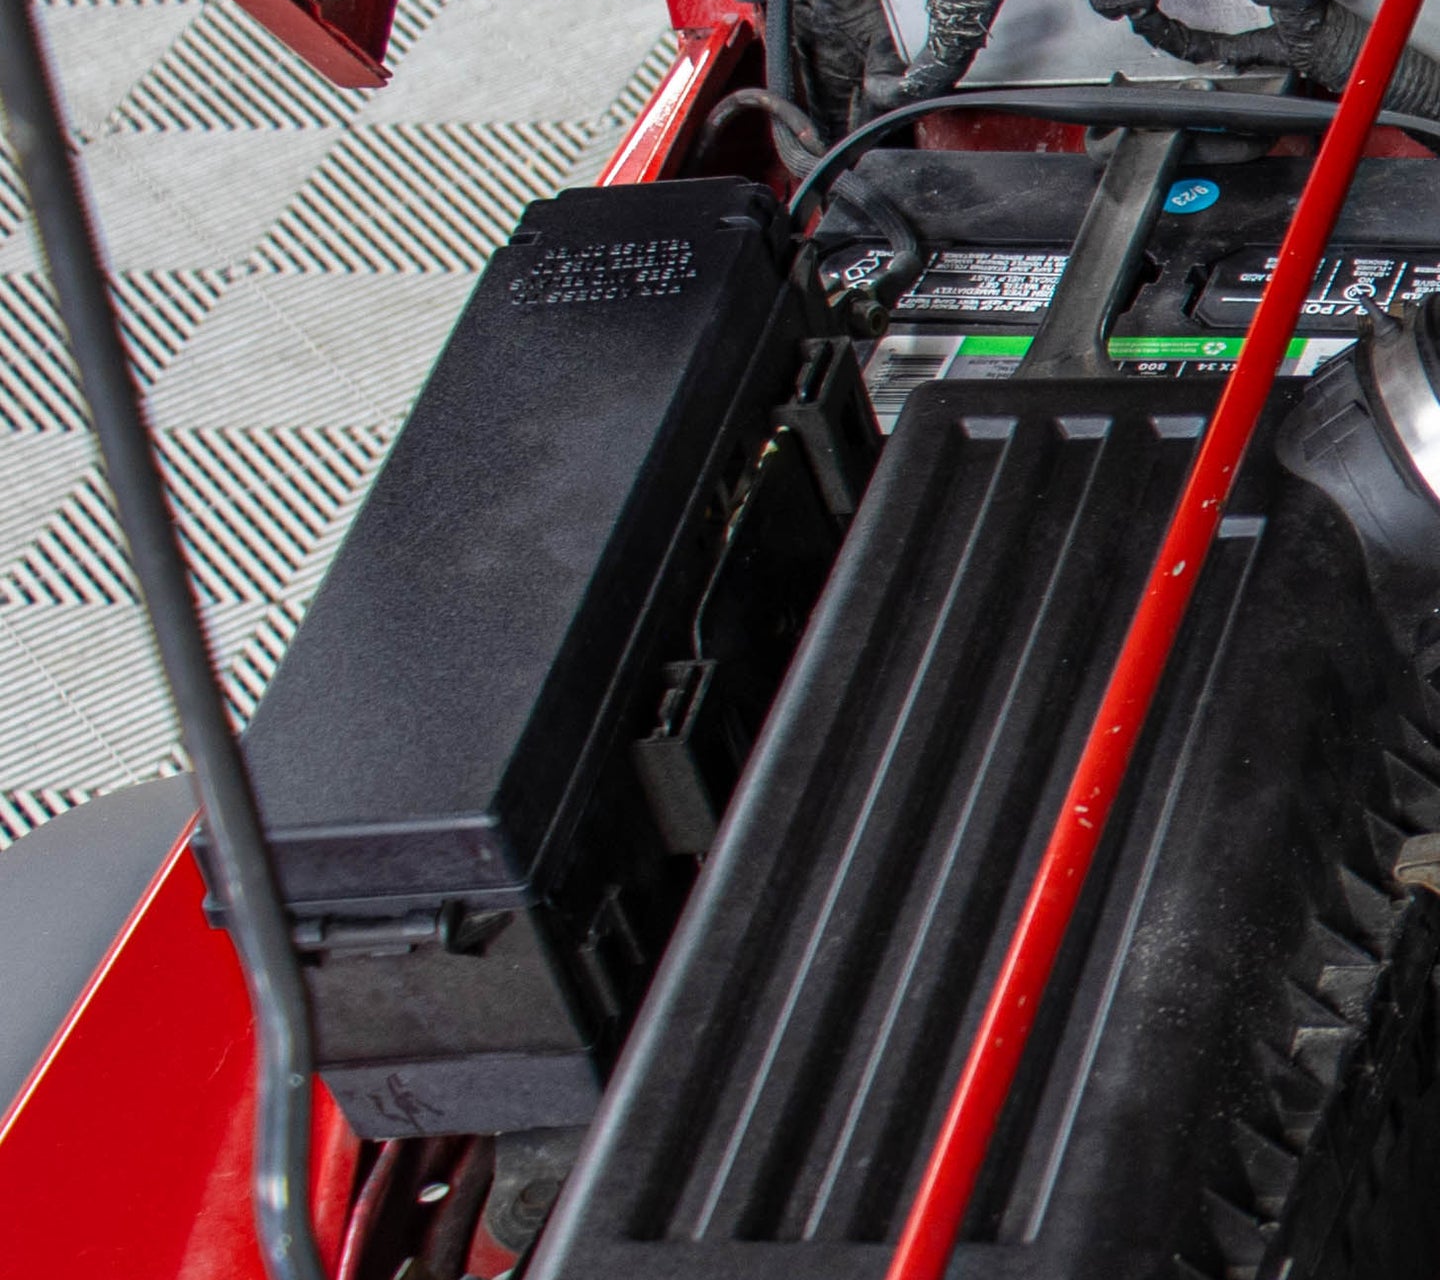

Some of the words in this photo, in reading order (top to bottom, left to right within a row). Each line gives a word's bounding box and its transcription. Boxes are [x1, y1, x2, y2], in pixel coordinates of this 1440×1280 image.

[1171, 185, 1208, 206] 9/23
[932, 287, 1001, 295] IMMEDIATELY
[1136, 362, 1168, 371] 800
[1196, 362, 1218, 371] 34
